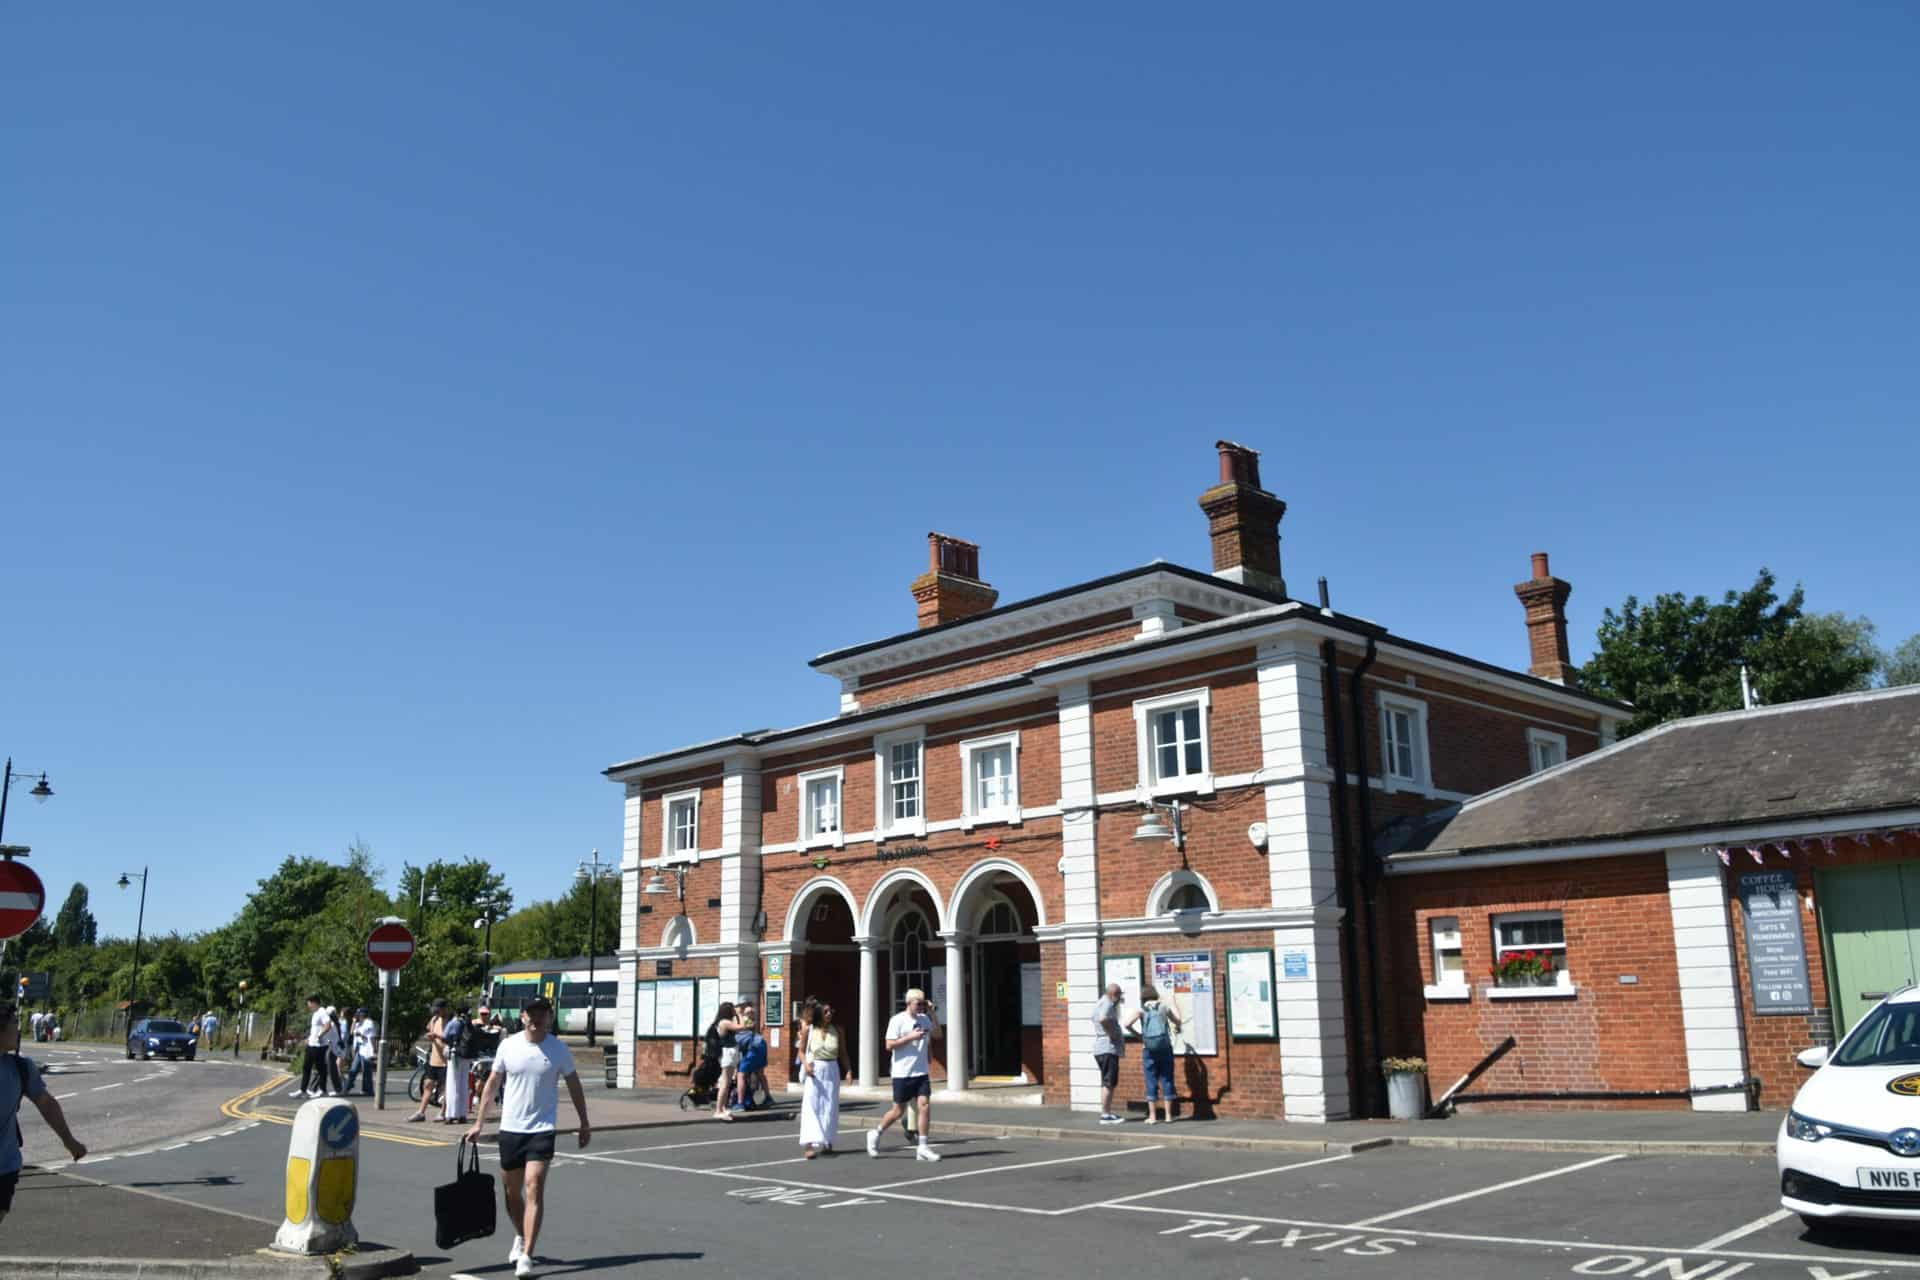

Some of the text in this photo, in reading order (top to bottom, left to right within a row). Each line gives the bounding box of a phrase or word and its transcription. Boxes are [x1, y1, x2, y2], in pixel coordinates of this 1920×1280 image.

[1741, 874, 1784, 886] COFFEE
[1870, 1171, 1910, 1187] NV16
[1157, 1219, 1416, 1256] TAXIS
